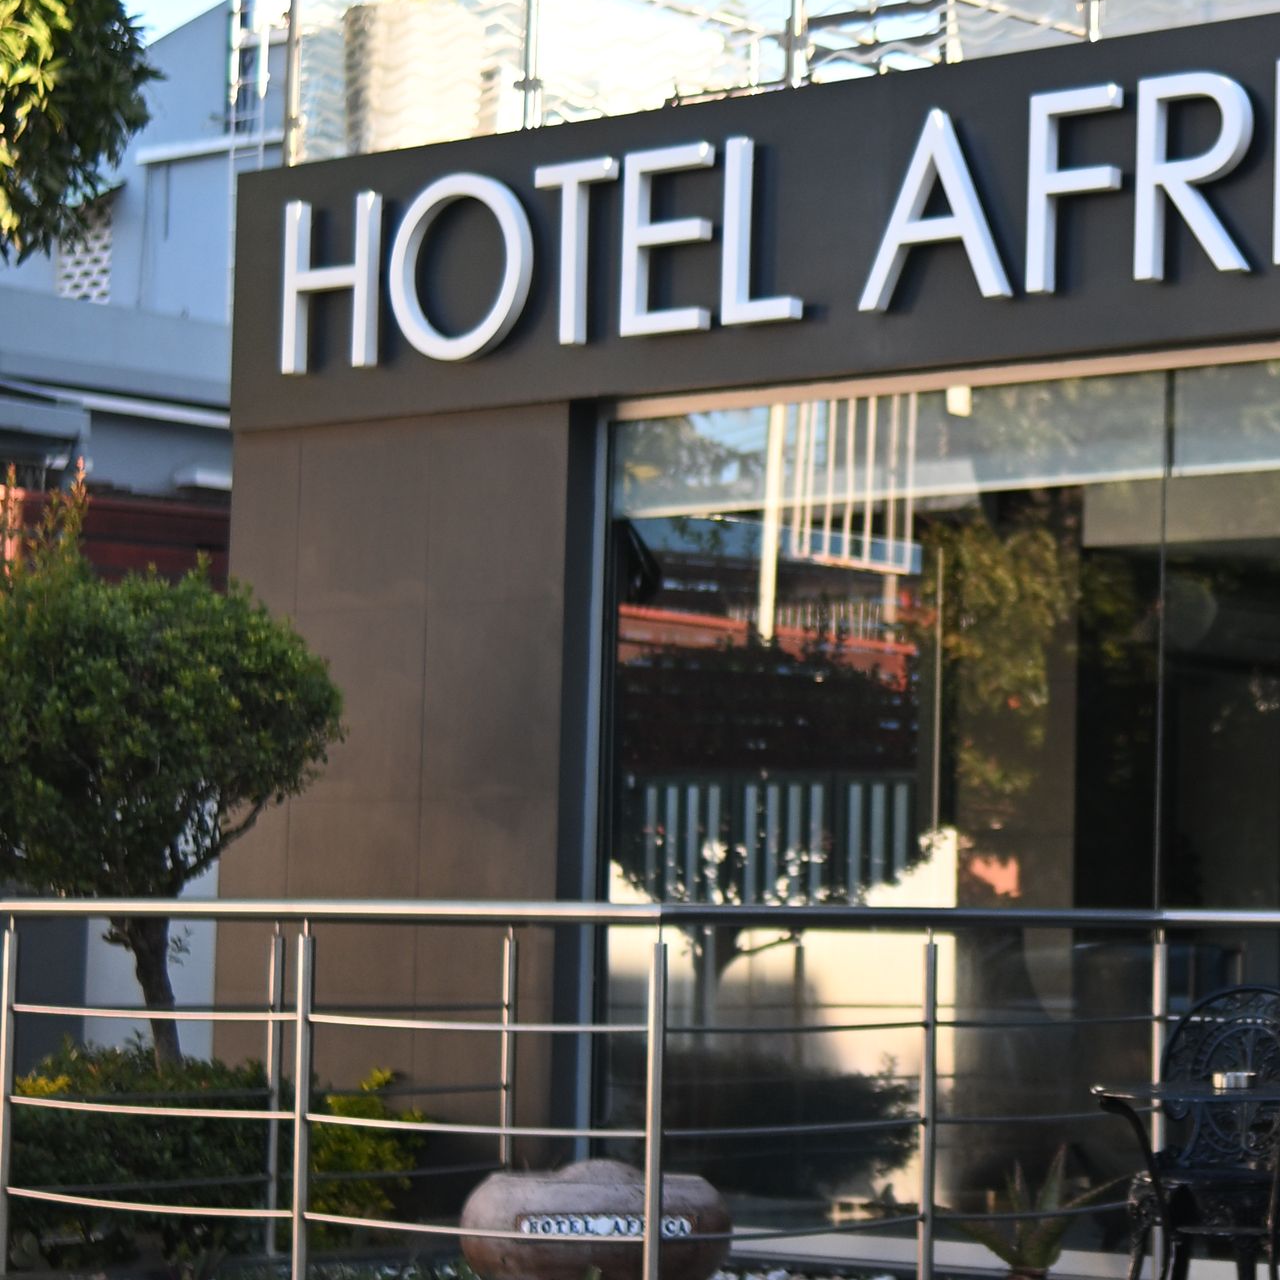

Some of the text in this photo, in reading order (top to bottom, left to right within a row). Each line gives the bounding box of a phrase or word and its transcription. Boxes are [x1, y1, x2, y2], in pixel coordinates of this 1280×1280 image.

[281, 136, 804, 376] HOTEL
[529, 1218, 688, 1235] HOTEL AFCA
